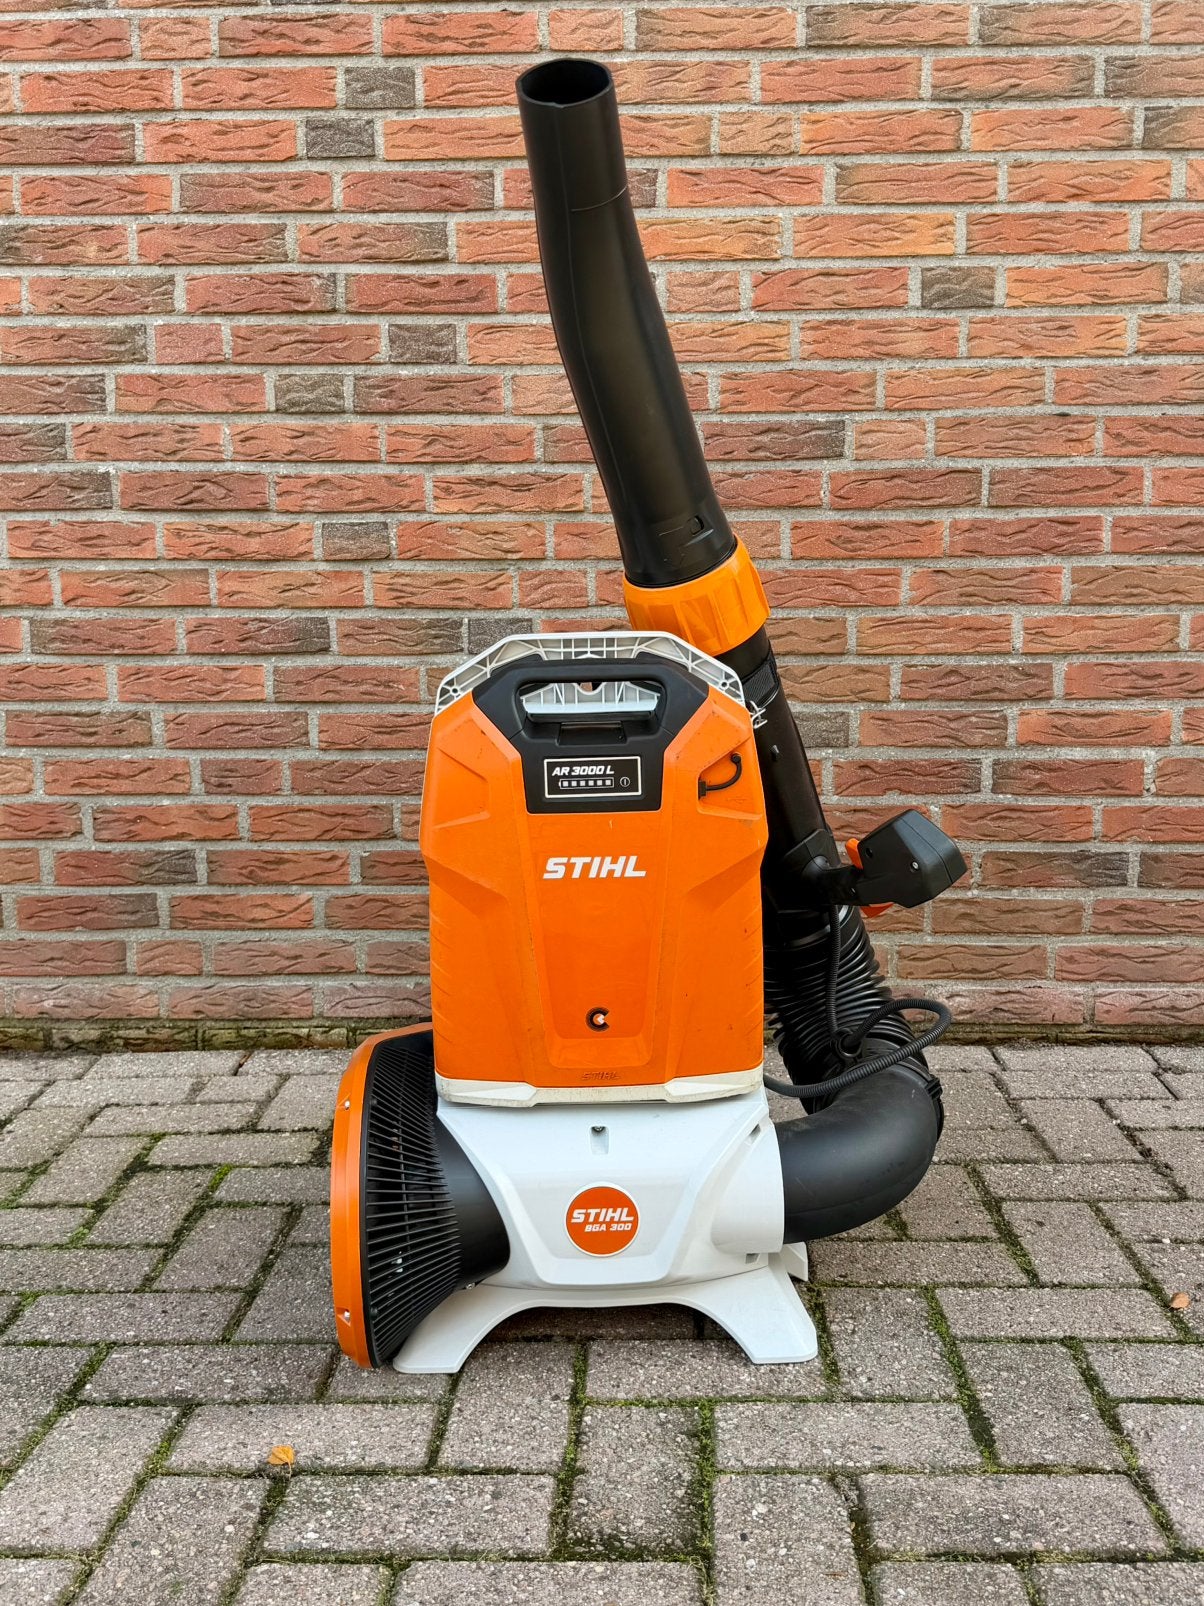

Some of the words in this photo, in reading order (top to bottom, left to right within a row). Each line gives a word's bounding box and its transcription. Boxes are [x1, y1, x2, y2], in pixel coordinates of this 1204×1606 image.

[552, 766, 570, 776] AR
[571, 765, 605, 776] 3000
[606, 765, 615, 775] L
[542, 855, 647, 879] STIHL
[582, 1071, 620, 1080] STIHL
[571, 1207, 634, 1223] STIHL
[584, 1224, 607, 1232] BGA
[609, 1223, 632, 1231] 300
